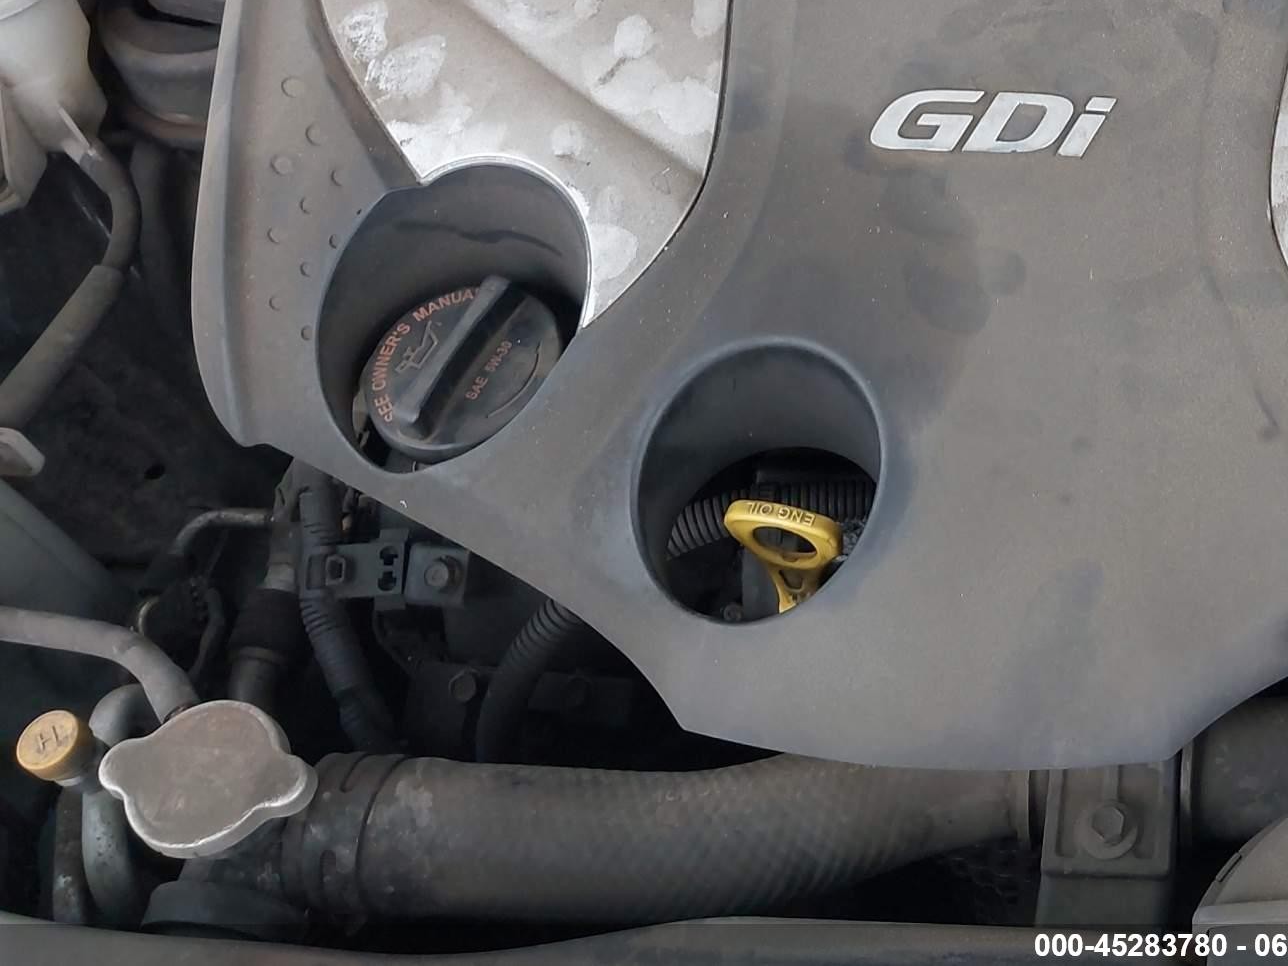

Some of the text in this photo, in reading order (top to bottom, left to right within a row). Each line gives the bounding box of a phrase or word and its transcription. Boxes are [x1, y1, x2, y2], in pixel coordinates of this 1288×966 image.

[870, 90, 1118, 158] GDi
[372, 322, 411, 391] OWNER'S
[465, 376, 489, 400] SAE
[374, 394, 394, 422] SEE
[747, 502, 816, 527] ENG OIL
